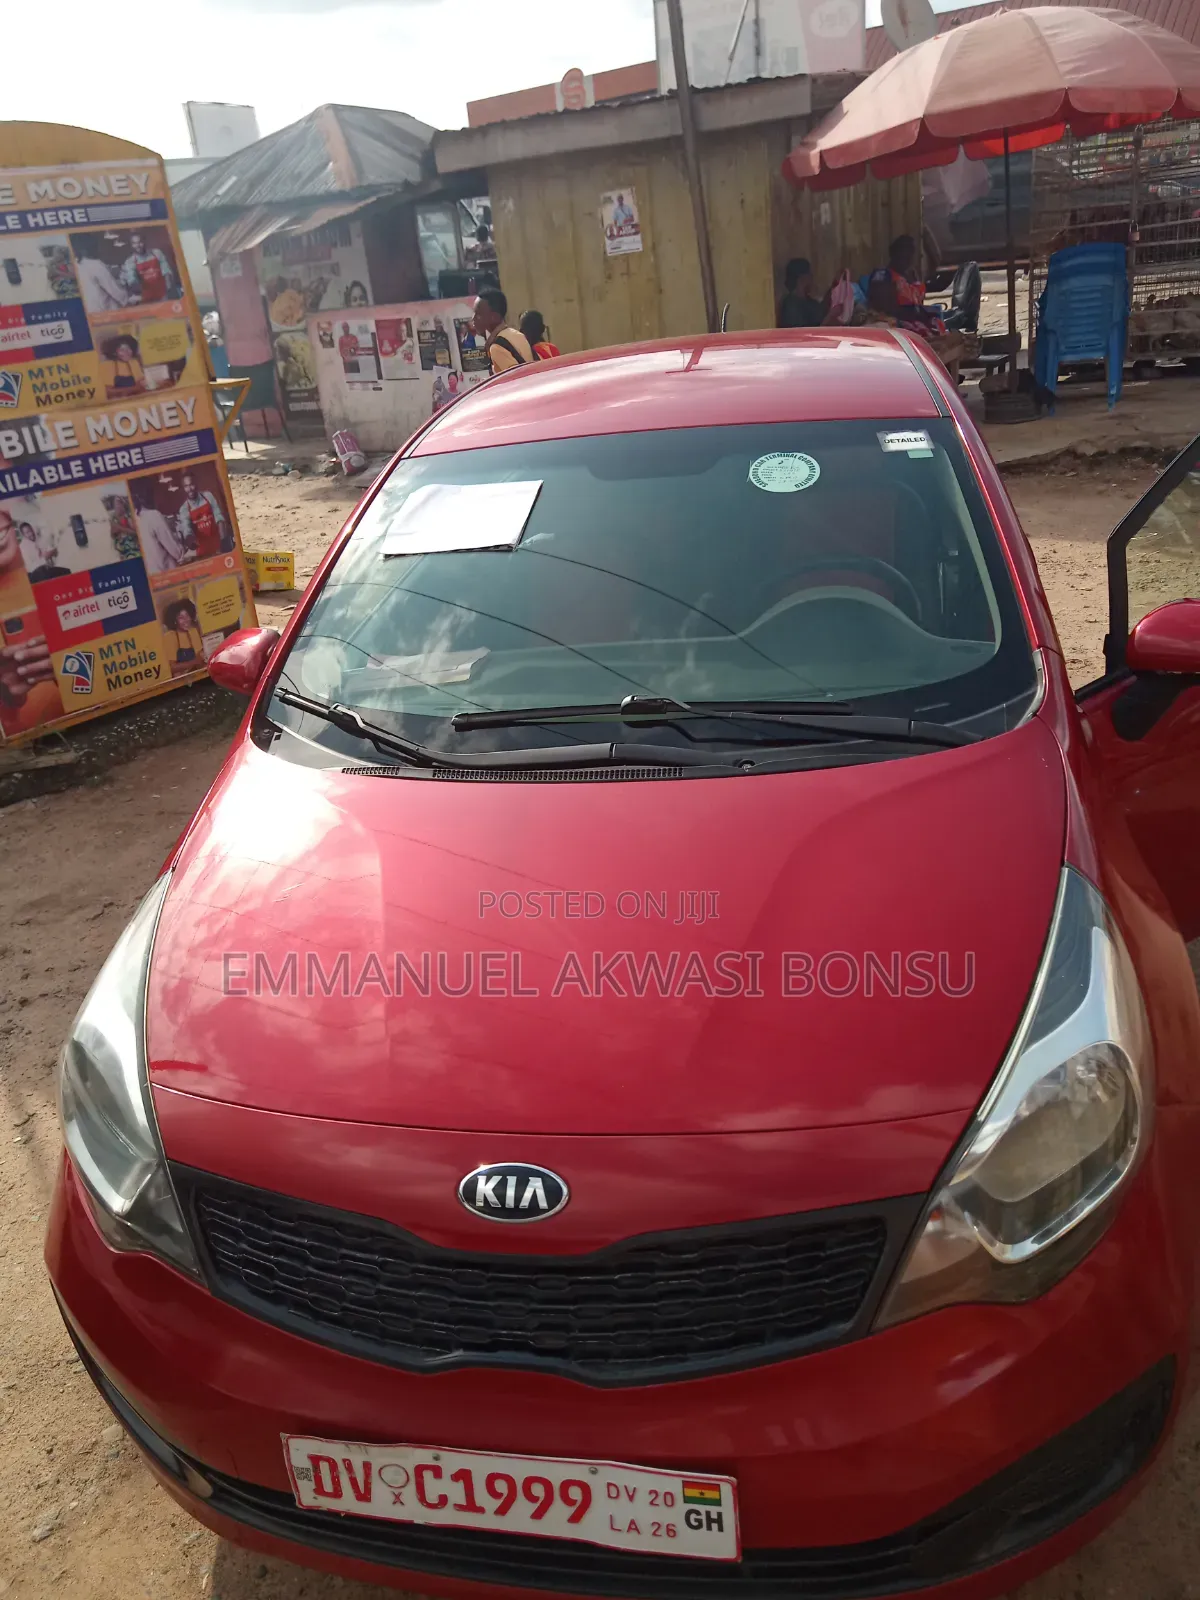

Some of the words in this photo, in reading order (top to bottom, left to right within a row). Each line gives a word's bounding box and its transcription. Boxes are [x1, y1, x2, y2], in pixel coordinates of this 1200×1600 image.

[27, 172, 149, 203] MONEY
[27, 208, 88, 228] HERE
[1, 329, 31, 343] airtel
[28, 363, 71, 380] MTN
[32, 374, 92, 394] Mobile
[36, 387, 96, 407] Money
[86, 396, 197, 444] MONEY
[884, 436, 926, 444] DETAILED
[88, 447, 144, 474] HERE
[764, 453, 798, 461] TERMINAL
[98, 575, 132, 588] Family
[73, 602, 100, 617] airtel
[98, 637, 136, 660] MTN
[103, 650, 157, 676] Mobile
[106, 664, 161, 691] Money
[475, 1175, 548, 1211] KIA
[307, 1453, 373, 1503] DV
[414, 1463, 593, 1525] C1999
[606, 1481, 638, 1503] DV
[648, 1488, 676, 1509] 20
[609, 1514, 641, 1535] LA
[651, 1519, 677, 1539] 26
[684, 1508, 724, 1533] GH
